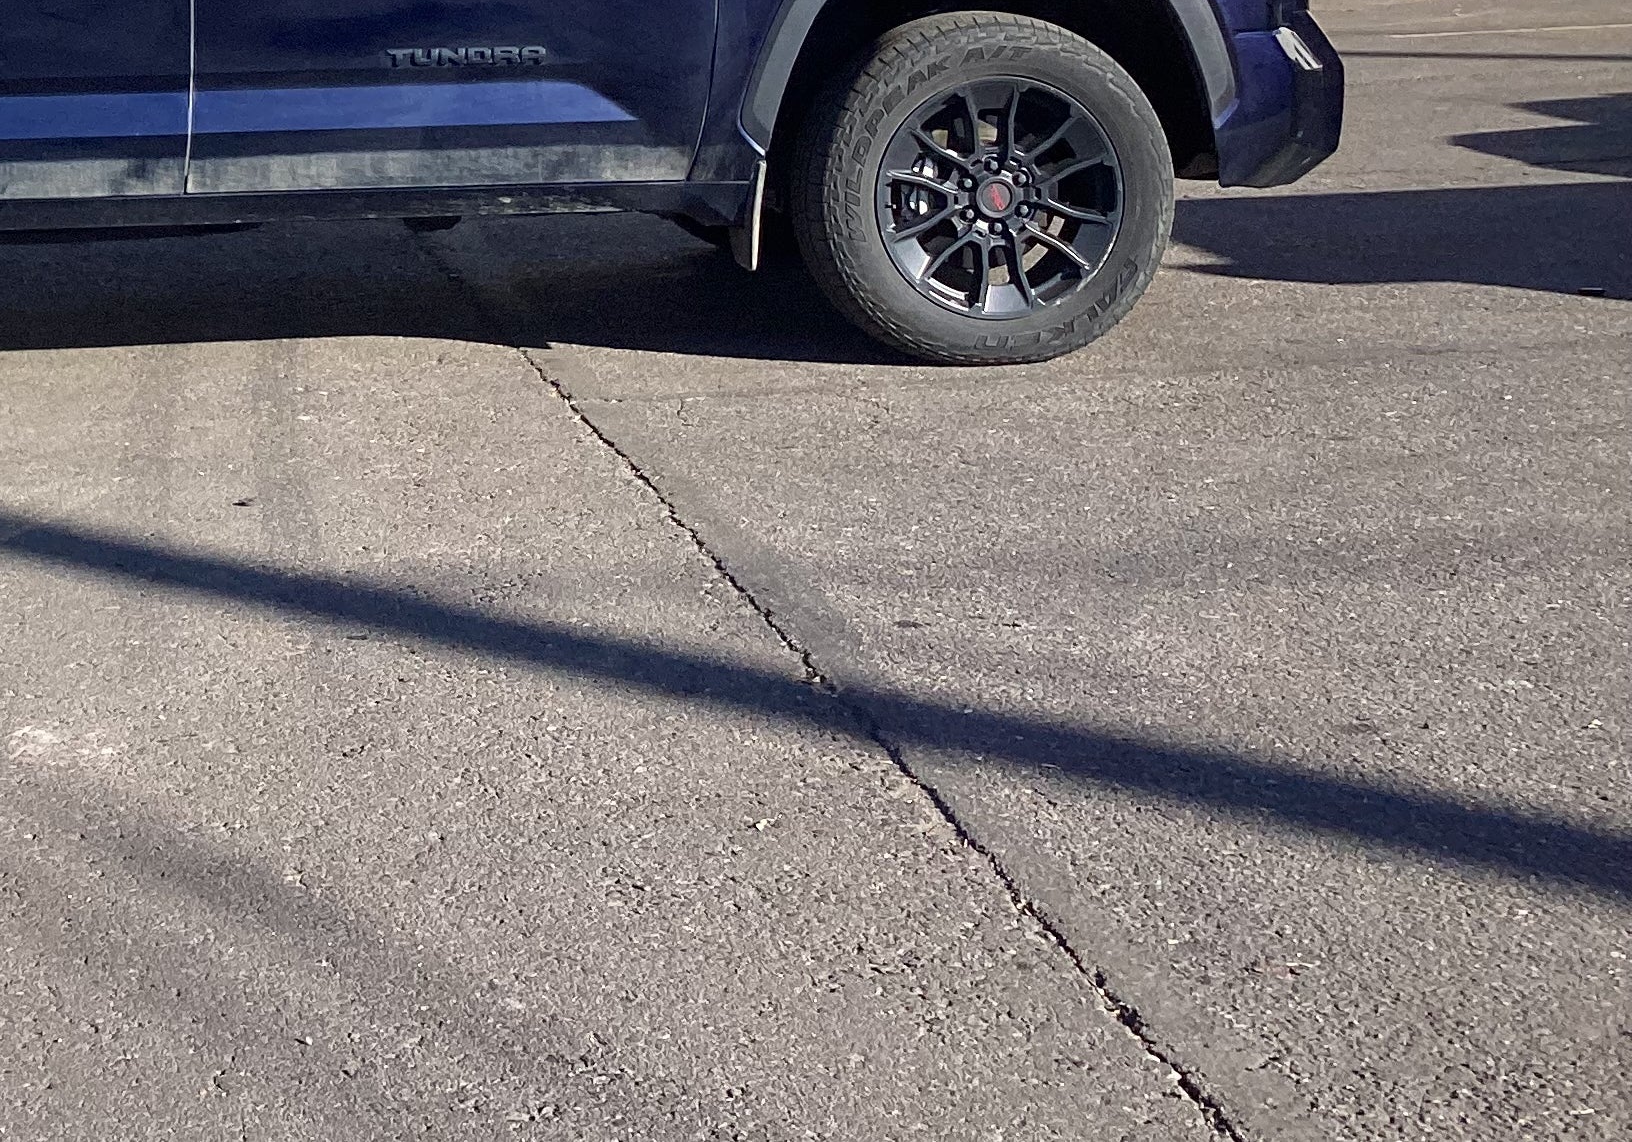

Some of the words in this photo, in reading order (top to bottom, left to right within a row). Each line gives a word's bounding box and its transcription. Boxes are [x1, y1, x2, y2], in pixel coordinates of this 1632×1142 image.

[386, 45, 547, 67] TUNDRA
[841, 54, 952, 243] WILDPEAK
[959, 45, 1033, 68] A/T
